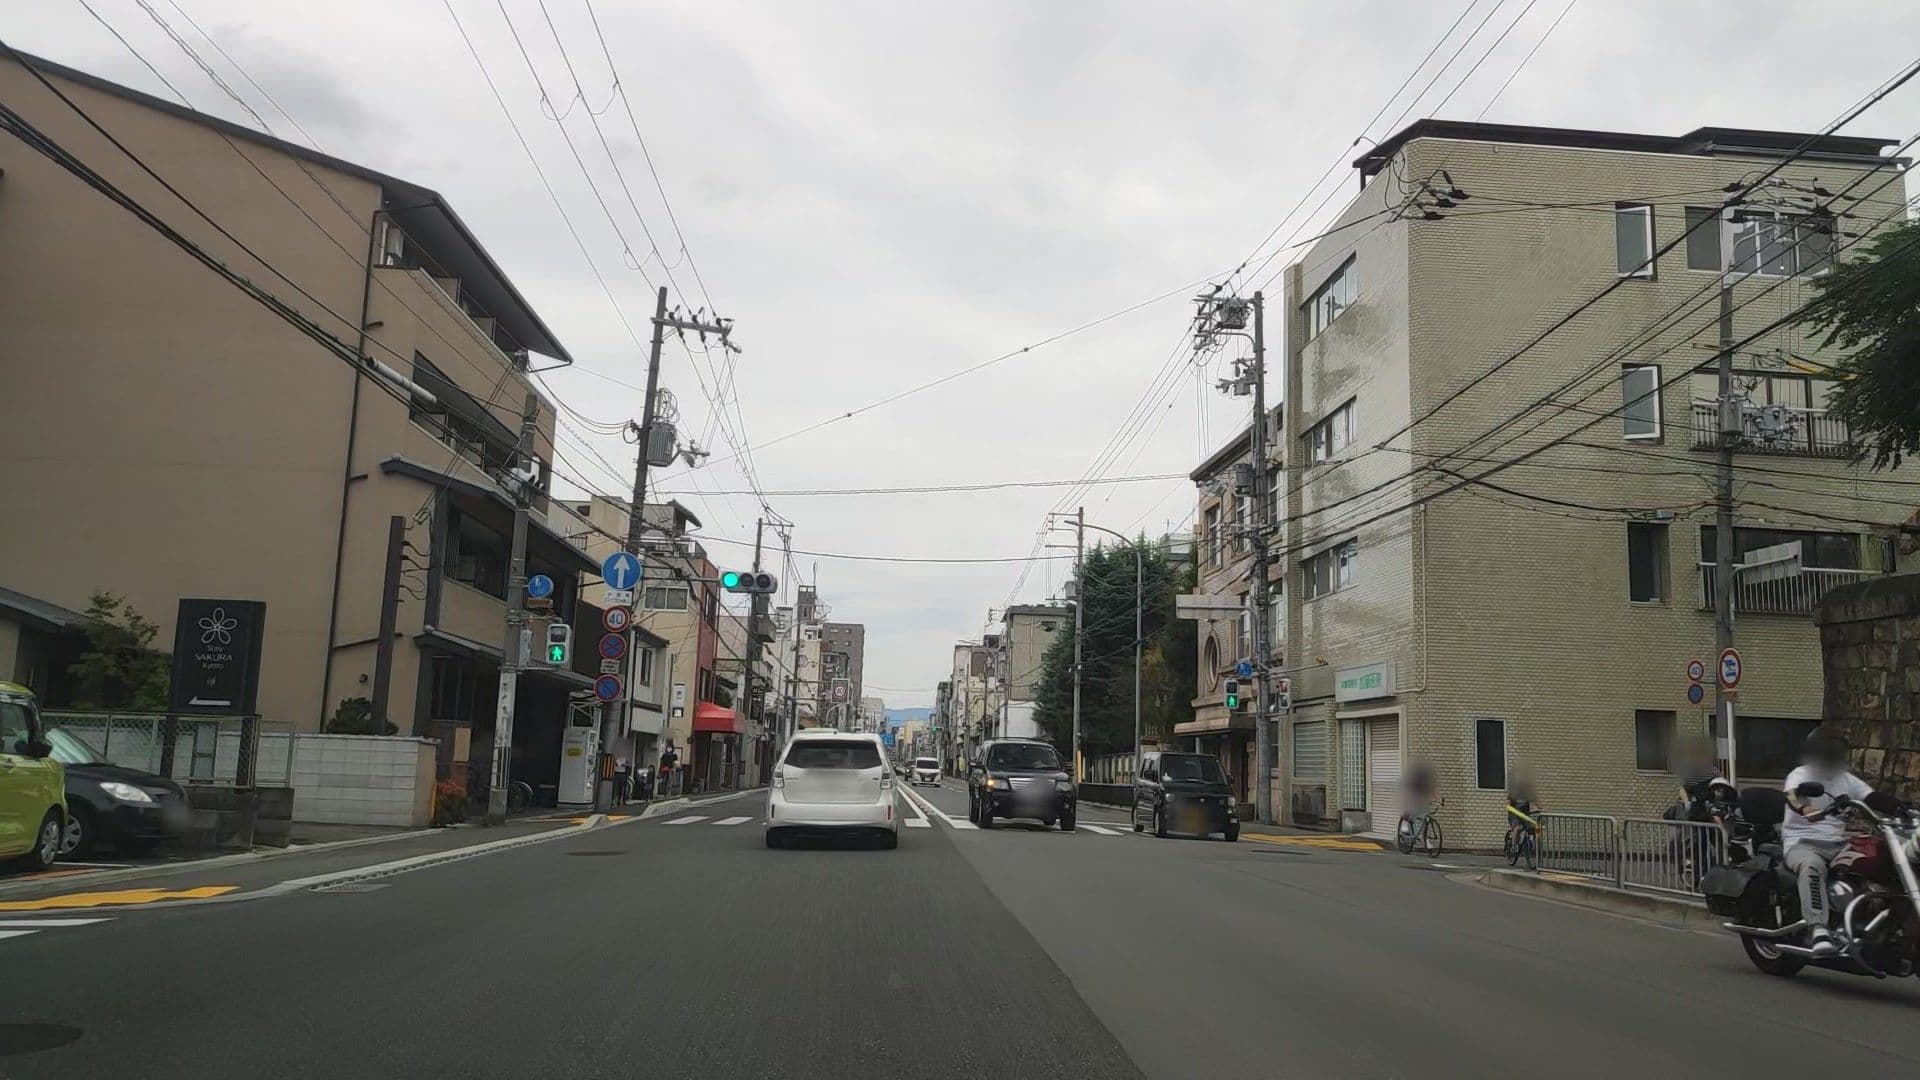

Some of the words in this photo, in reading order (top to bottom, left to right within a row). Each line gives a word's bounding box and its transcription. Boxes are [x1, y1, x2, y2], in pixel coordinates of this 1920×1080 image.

[609, 613, 624, 625] 40
[195, 653, 233, 662] SAKURA
[1691, 666, 1701, 676] 40
